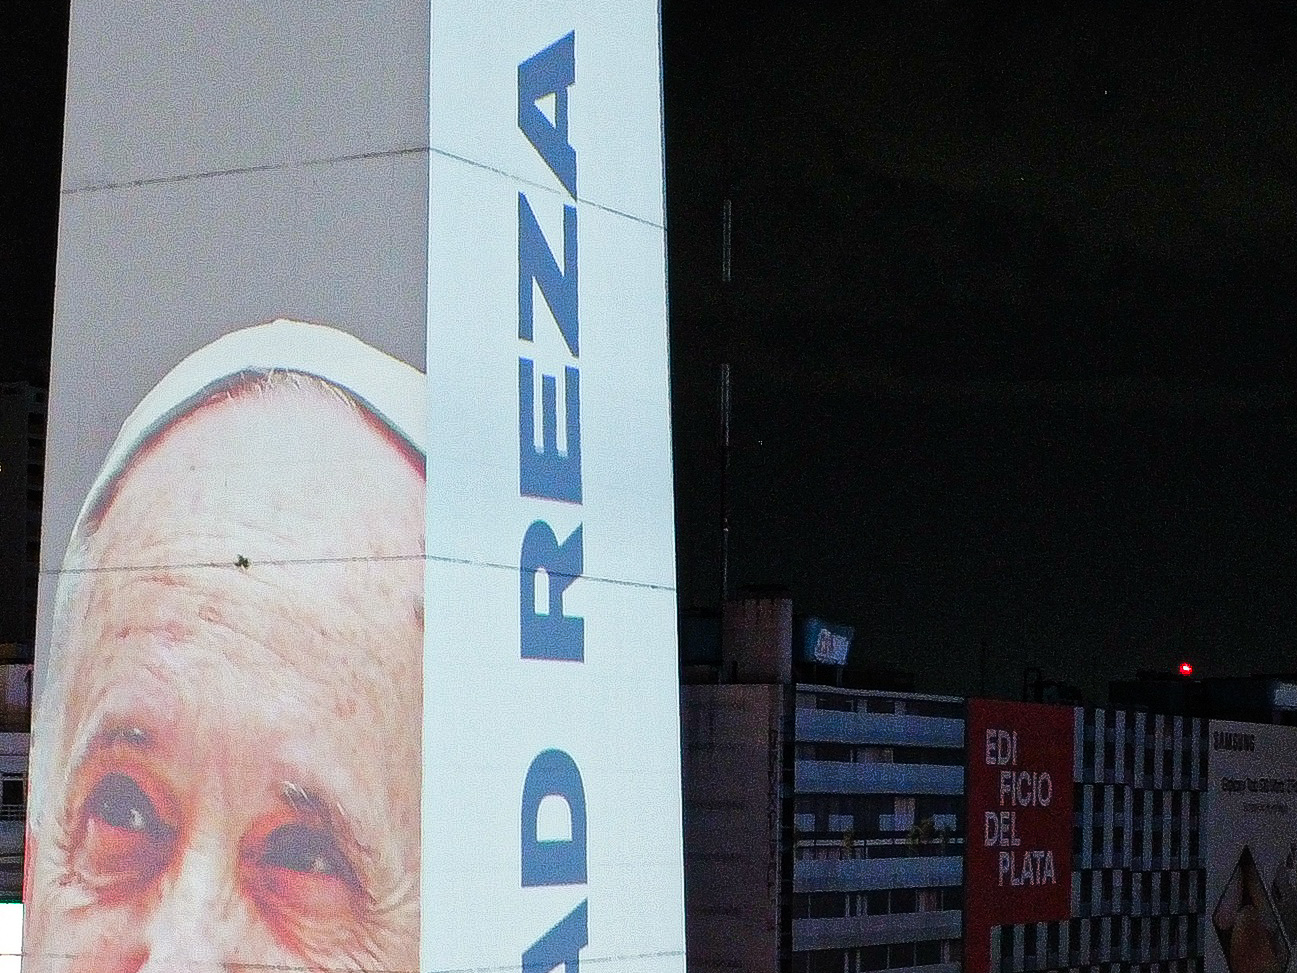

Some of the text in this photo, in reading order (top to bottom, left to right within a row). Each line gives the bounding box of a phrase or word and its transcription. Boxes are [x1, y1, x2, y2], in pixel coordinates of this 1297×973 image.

[516, 28, 585, 663] REZA
[985, 728, 1018, 765] EDI
[999, 770, 1052, 806] FICIO
[984, 811, 1021, 846] DEL
[998, 850, 1057, 886] PLATA
